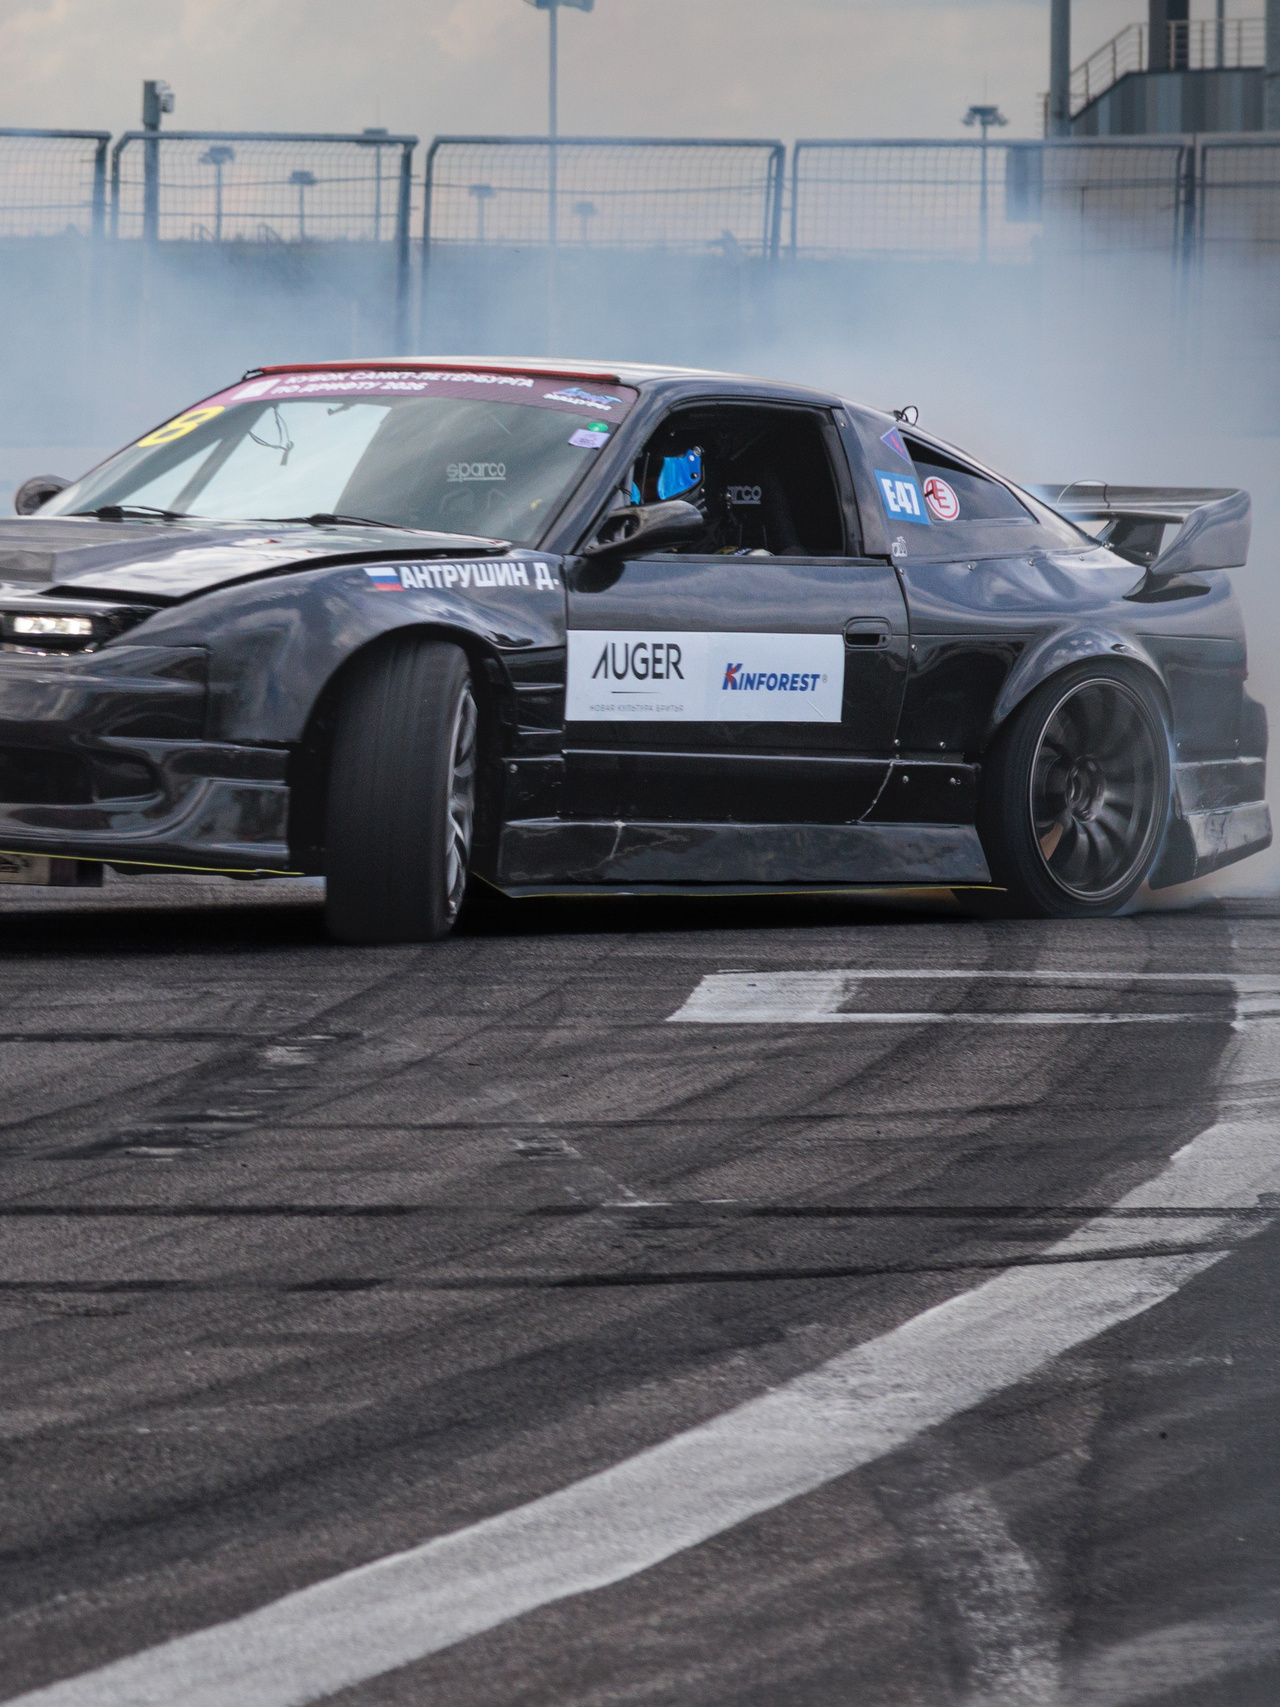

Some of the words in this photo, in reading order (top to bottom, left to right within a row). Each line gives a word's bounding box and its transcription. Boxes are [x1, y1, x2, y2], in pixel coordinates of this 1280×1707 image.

[137, 405, 225, 447] 8
[447, 462, 506, 482] sparco
[881, 478, 920, 516] E47
[398, 563, 530, 589] АНТРУШИН
[533, 562, 559, 590] Д.
[591, 640, 685, 680] AUGER
[722, 663, 820, 691] KINFOREST
